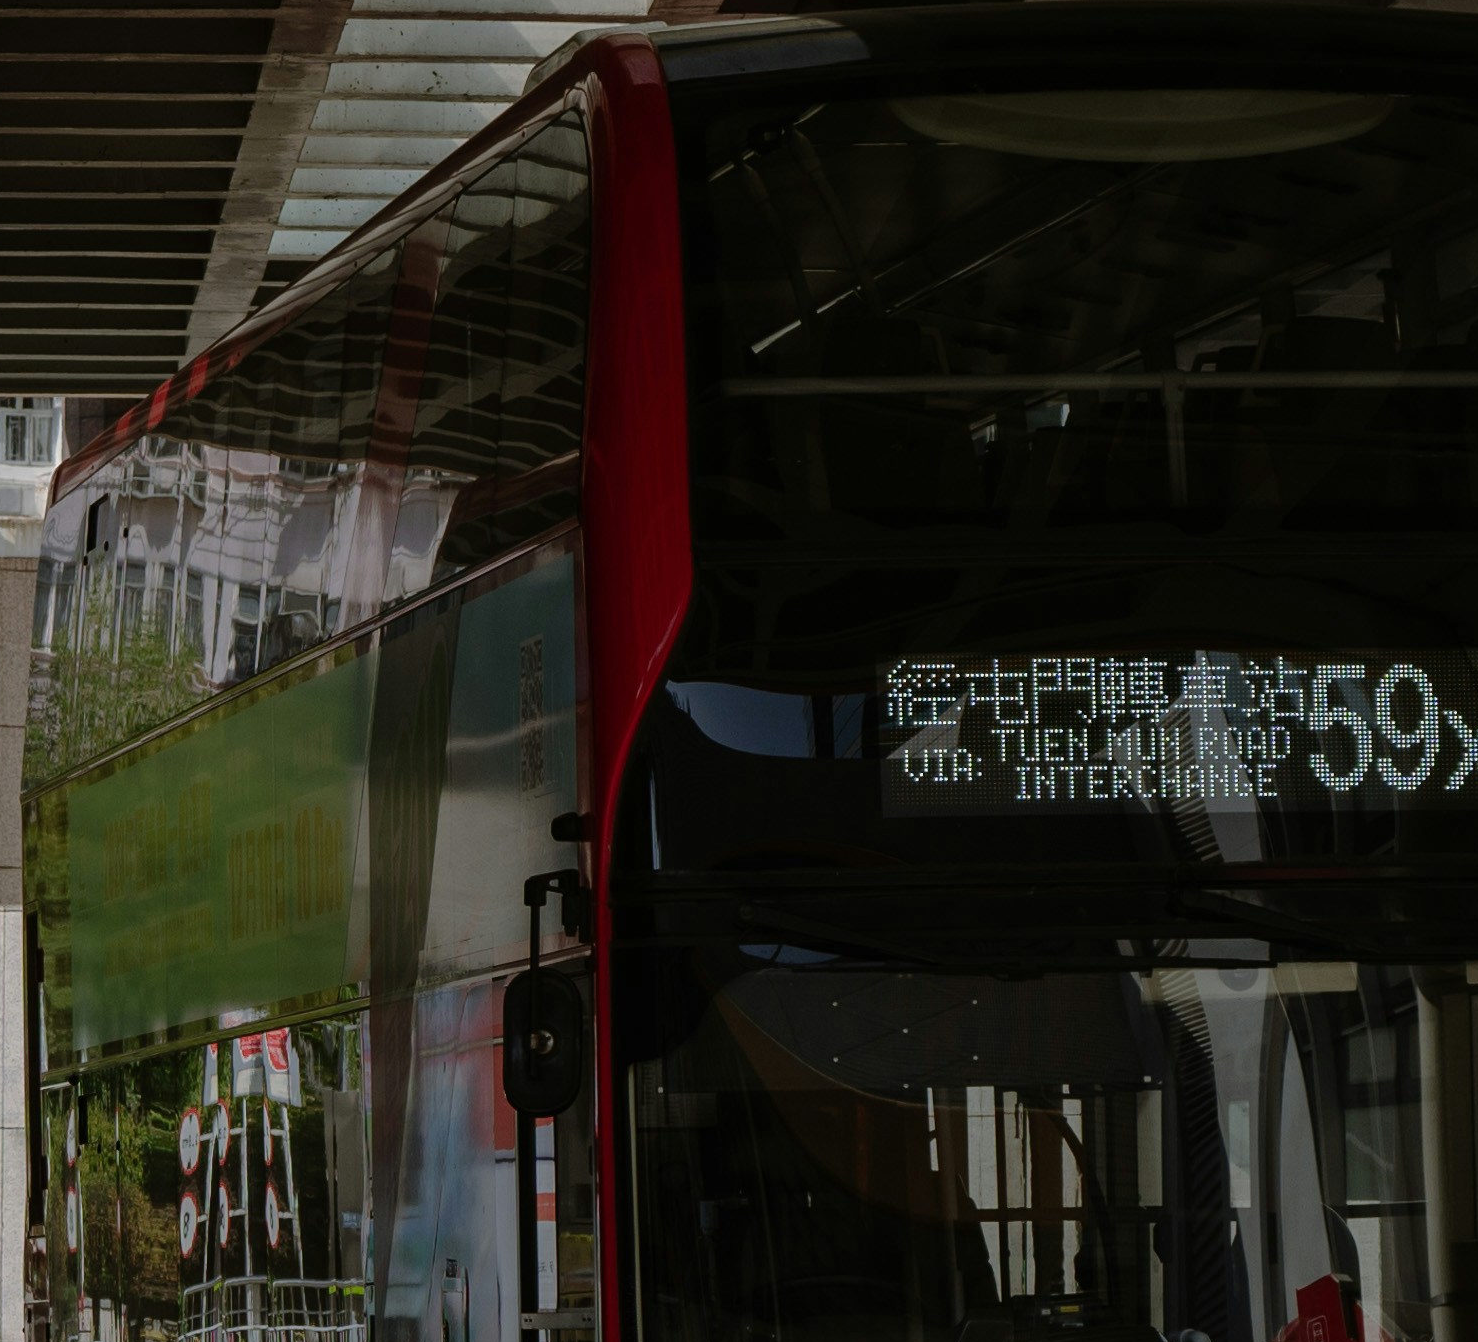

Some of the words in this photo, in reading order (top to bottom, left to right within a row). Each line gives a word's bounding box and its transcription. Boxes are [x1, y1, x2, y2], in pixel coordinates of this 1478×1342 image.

[991, 728, 1090, 763] TUEN
[1107, 726, 1181, 761] MUN
[1200, 725, 1292, 760] ROAD
[903, 747, 983, 782] VIA:
[1016, 764, 1279, 801] INTERCHANGE
